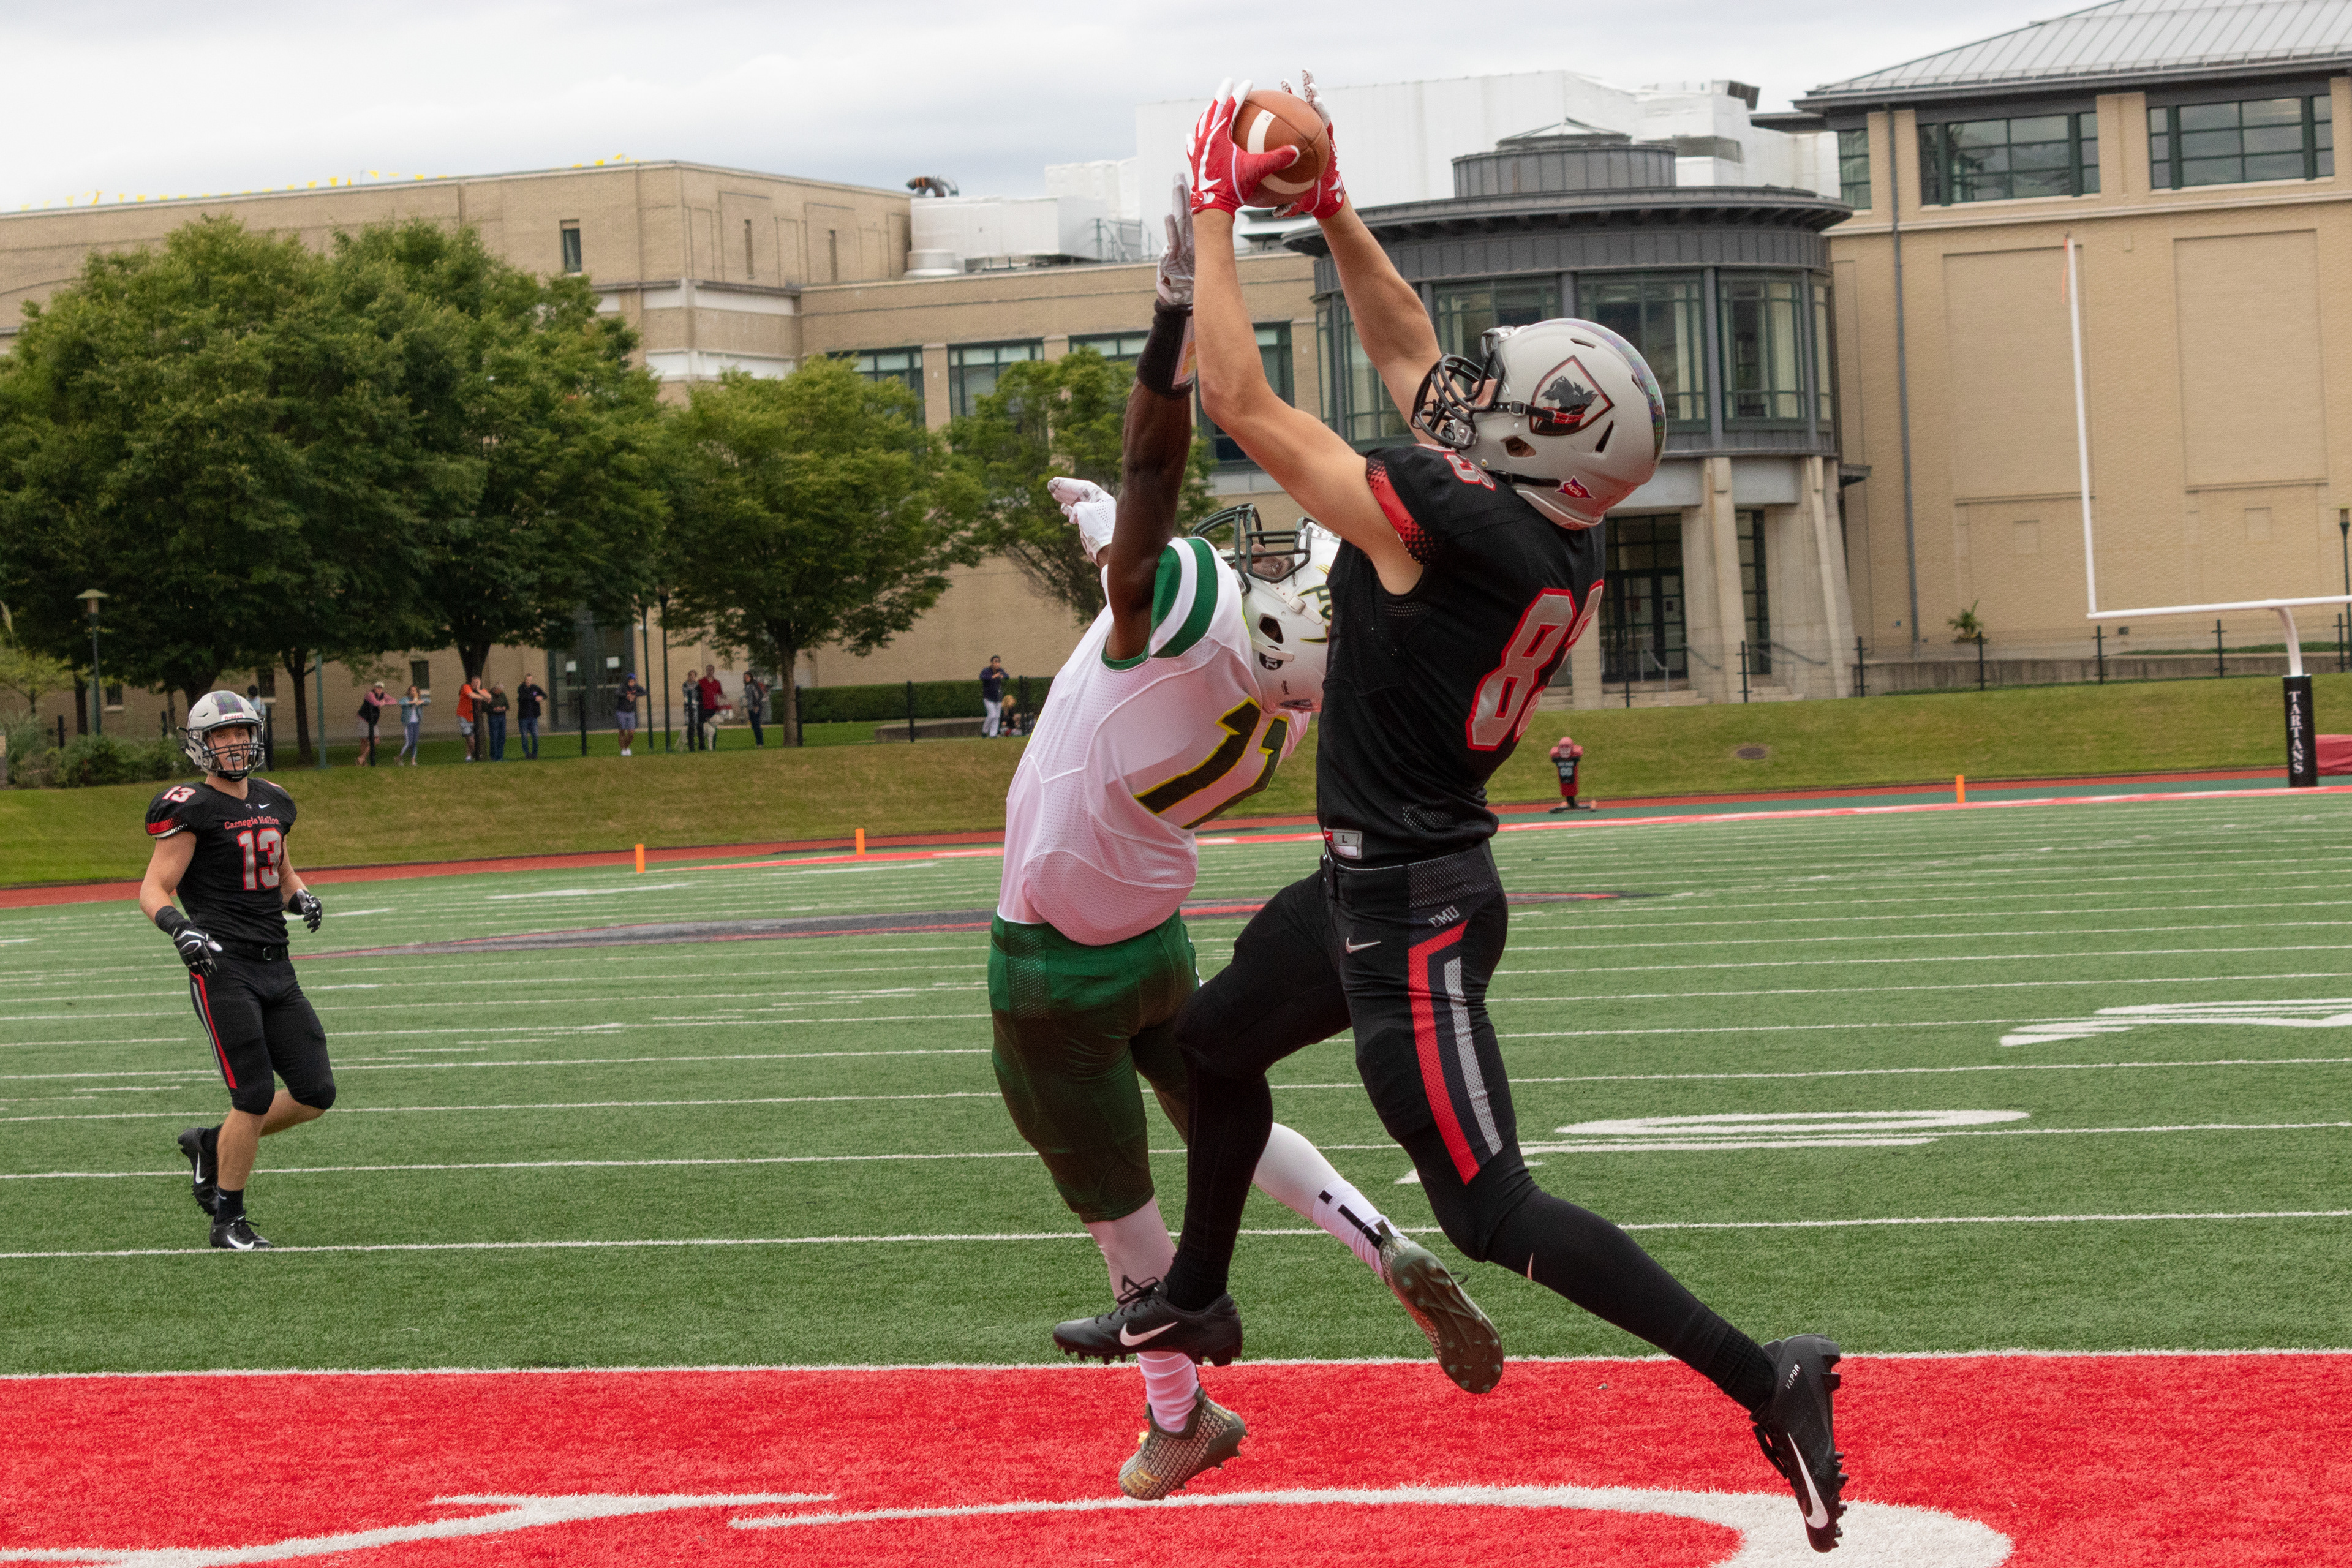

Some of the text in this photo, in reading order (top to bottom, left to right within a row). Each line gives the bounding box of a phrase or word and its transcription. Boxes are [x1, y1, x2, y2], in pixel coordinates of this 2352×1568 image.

[2288, 690, 2304, 774] TARTANS
[162, 786, 196, 802] 13
[224, 816, 280, 830] Carnegie Mellon
[1341, 834, 1348, 843] L
[236, 827, 282, 891] 13
[1428, 905, 1460, 928] CMU
[1785, 1363, 1800, 1389] VAPOR
